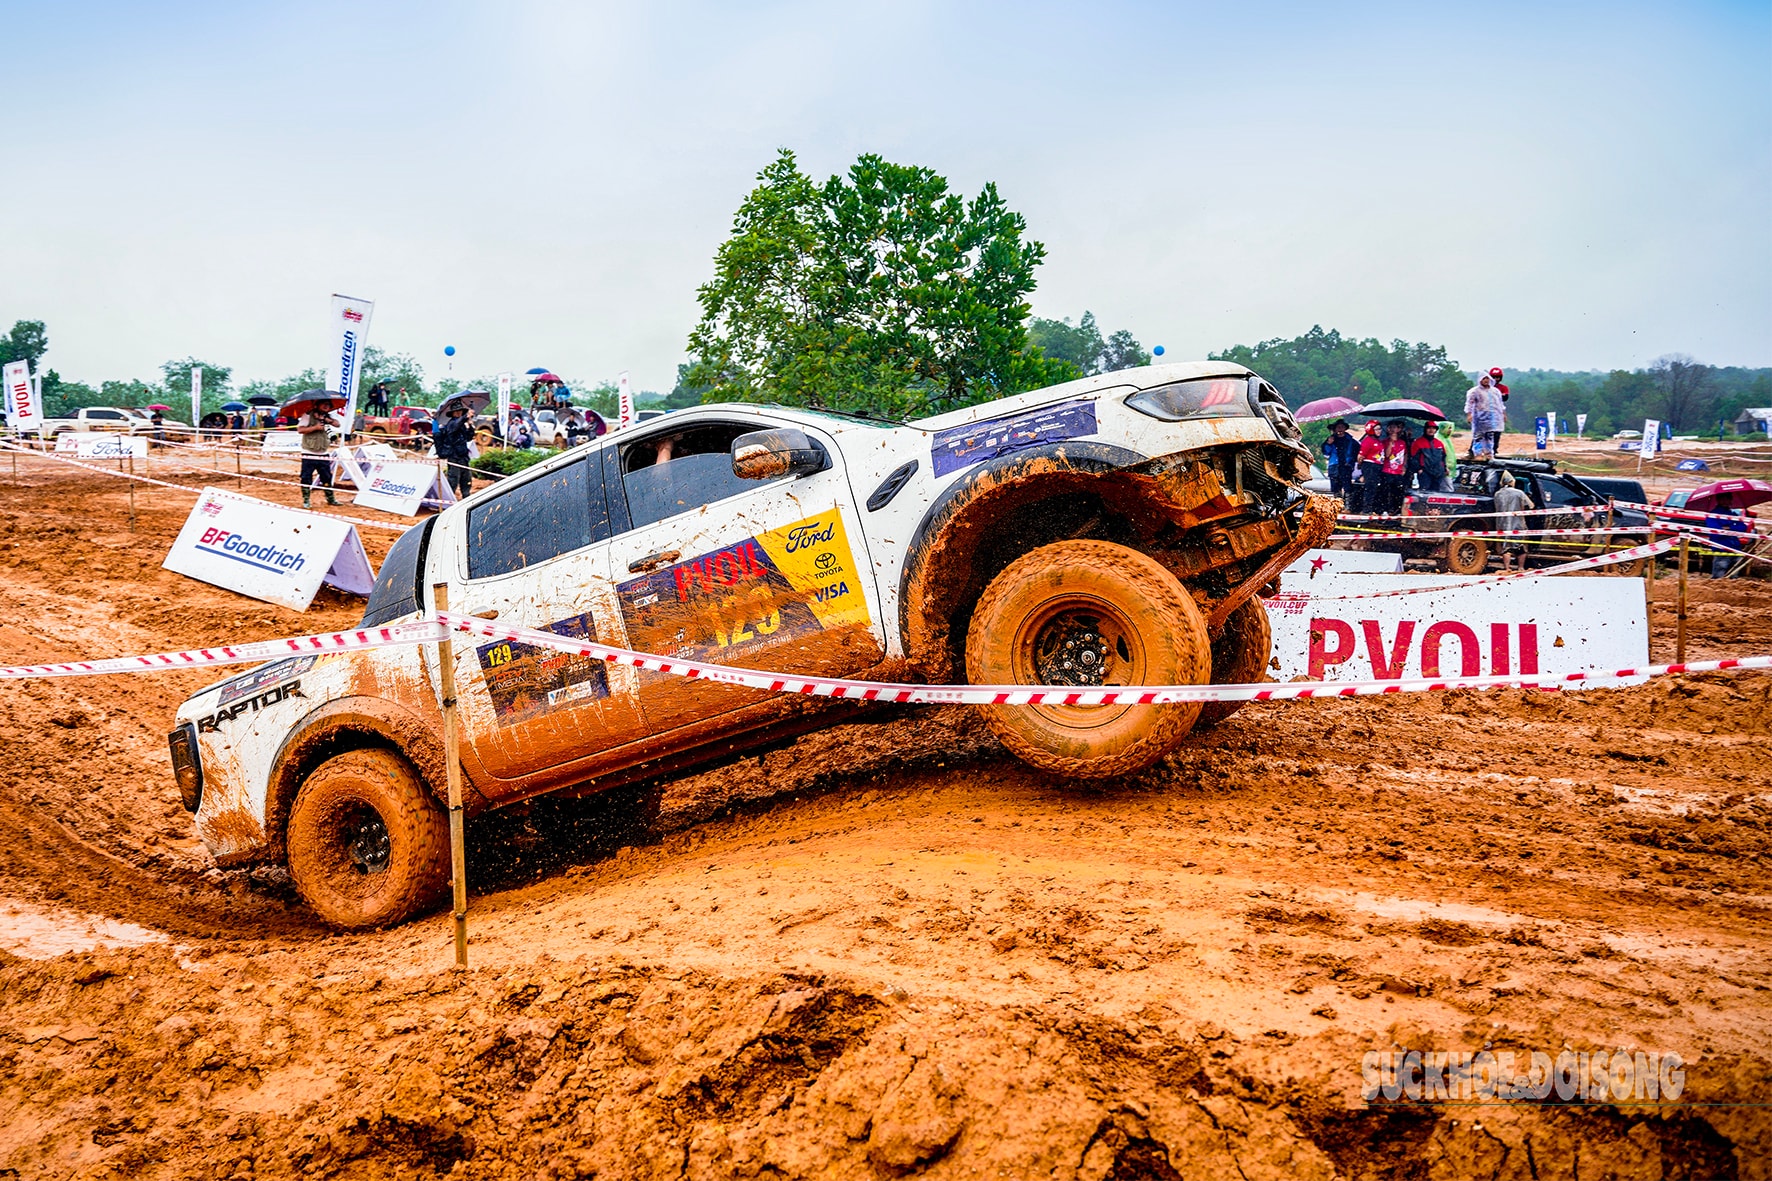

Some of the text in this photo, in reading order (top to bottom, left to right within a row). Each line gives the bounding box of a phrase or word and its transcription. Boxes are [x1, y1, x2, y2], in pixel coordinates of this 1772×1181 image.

[336, 330, 355, 417] BGoodrich
[14, 381, 32, 418] PVOIL
[92, 441, 133, 455] Ford
[371, 478, 416, 496] BFGoodrich
[199, 526, 306, 571] BFGoodrich
[785, 521, 836, 554] Ford
[673, 542, 768, 603] PVOIL
[814, 565, 844, 580] TOYOTA
[813, 580, 851, 603] VISA
[487, 644, 512, 667] 129
[197, 680, 308, 734] RAPTOR
